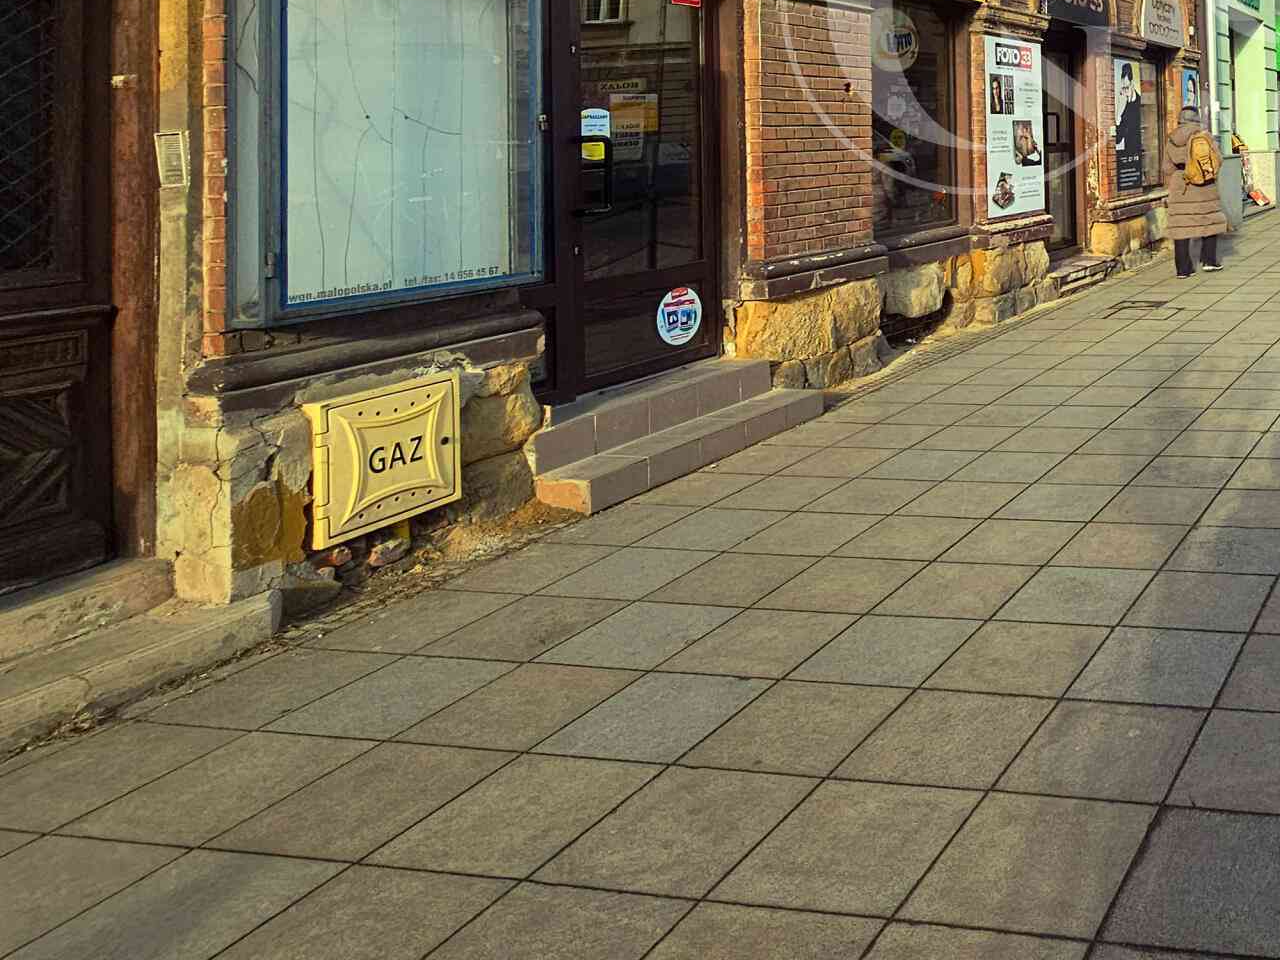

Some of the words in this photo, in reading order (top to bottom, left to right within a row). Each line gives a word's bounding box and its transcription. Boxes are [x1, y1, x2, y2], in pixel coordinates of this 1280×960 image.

[996, 45, 1020, 65] FOTO
[1020, 47, 1032, 66] 33
[369, 435, 423, 474] GAZ
